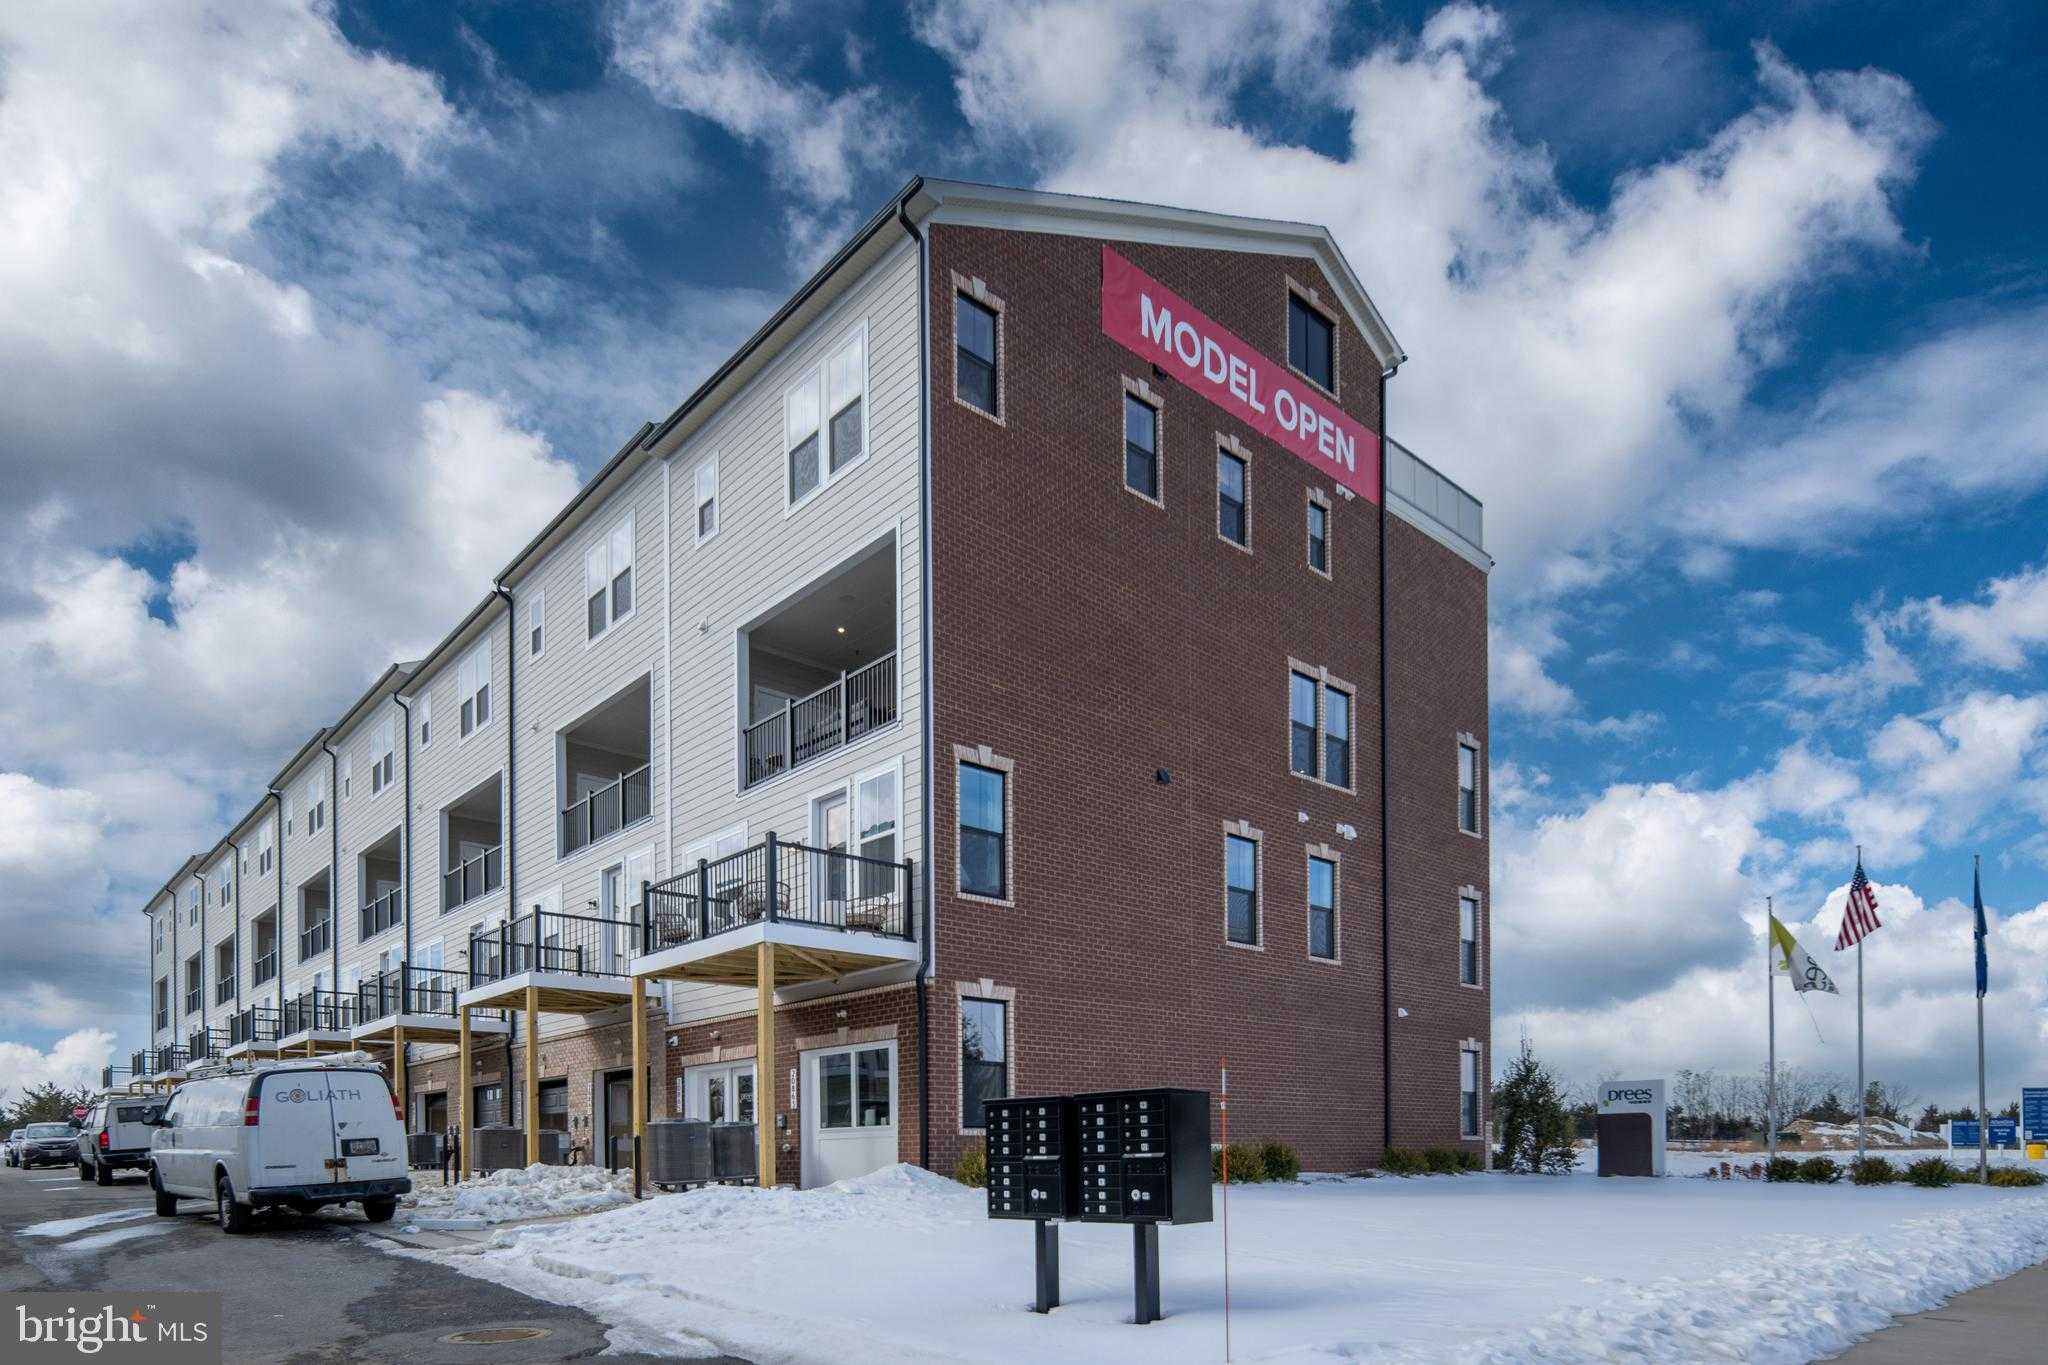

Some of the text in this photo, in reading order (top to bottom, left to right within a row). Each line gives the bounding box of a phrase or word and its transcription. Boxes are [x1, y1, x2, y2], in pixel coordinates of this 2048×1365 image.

[1140, 292, 1356, 473] MODEL OPEN
[275, 1088, 362, 1103] GOLIATH
